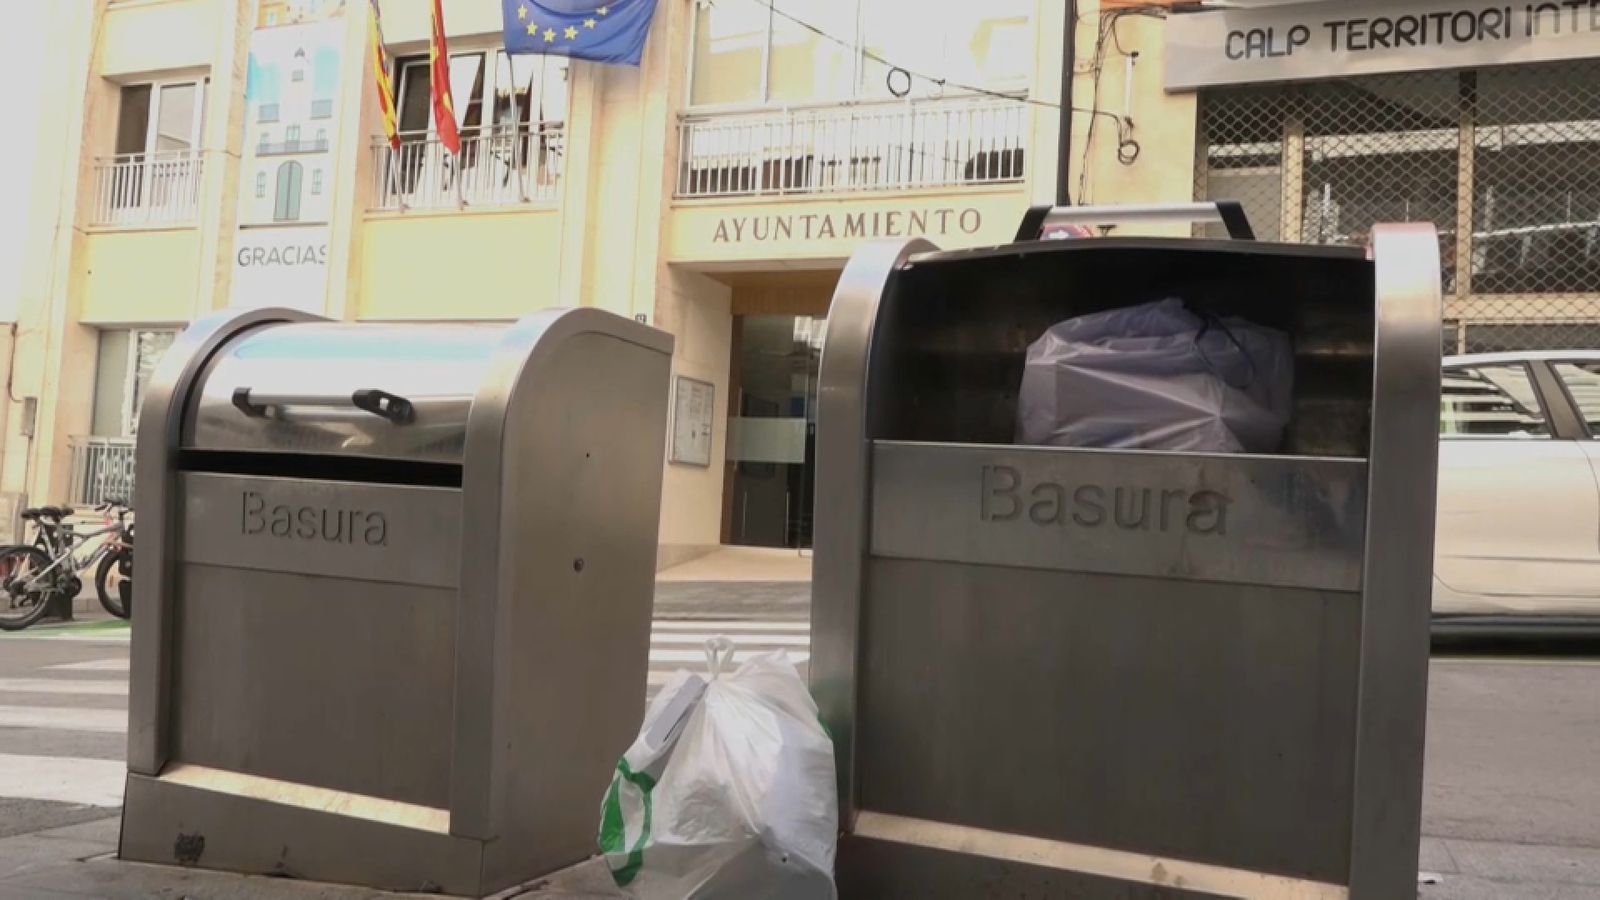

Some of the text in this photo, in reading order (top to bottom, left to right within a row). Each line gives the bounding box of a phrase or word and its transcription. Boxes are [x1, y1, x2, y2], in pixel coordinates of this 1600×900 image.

[1225, 24, 1311, 60] CALP
[1323, 6, 1511, 52] TERRITORI
[712, 207, 982, 243] AYUNTAMIENTO
[237, 244, 327, 267] GRACIAS
[241, 491, 388, 547] Basura
[979, 464, 1229, 536] Basura
